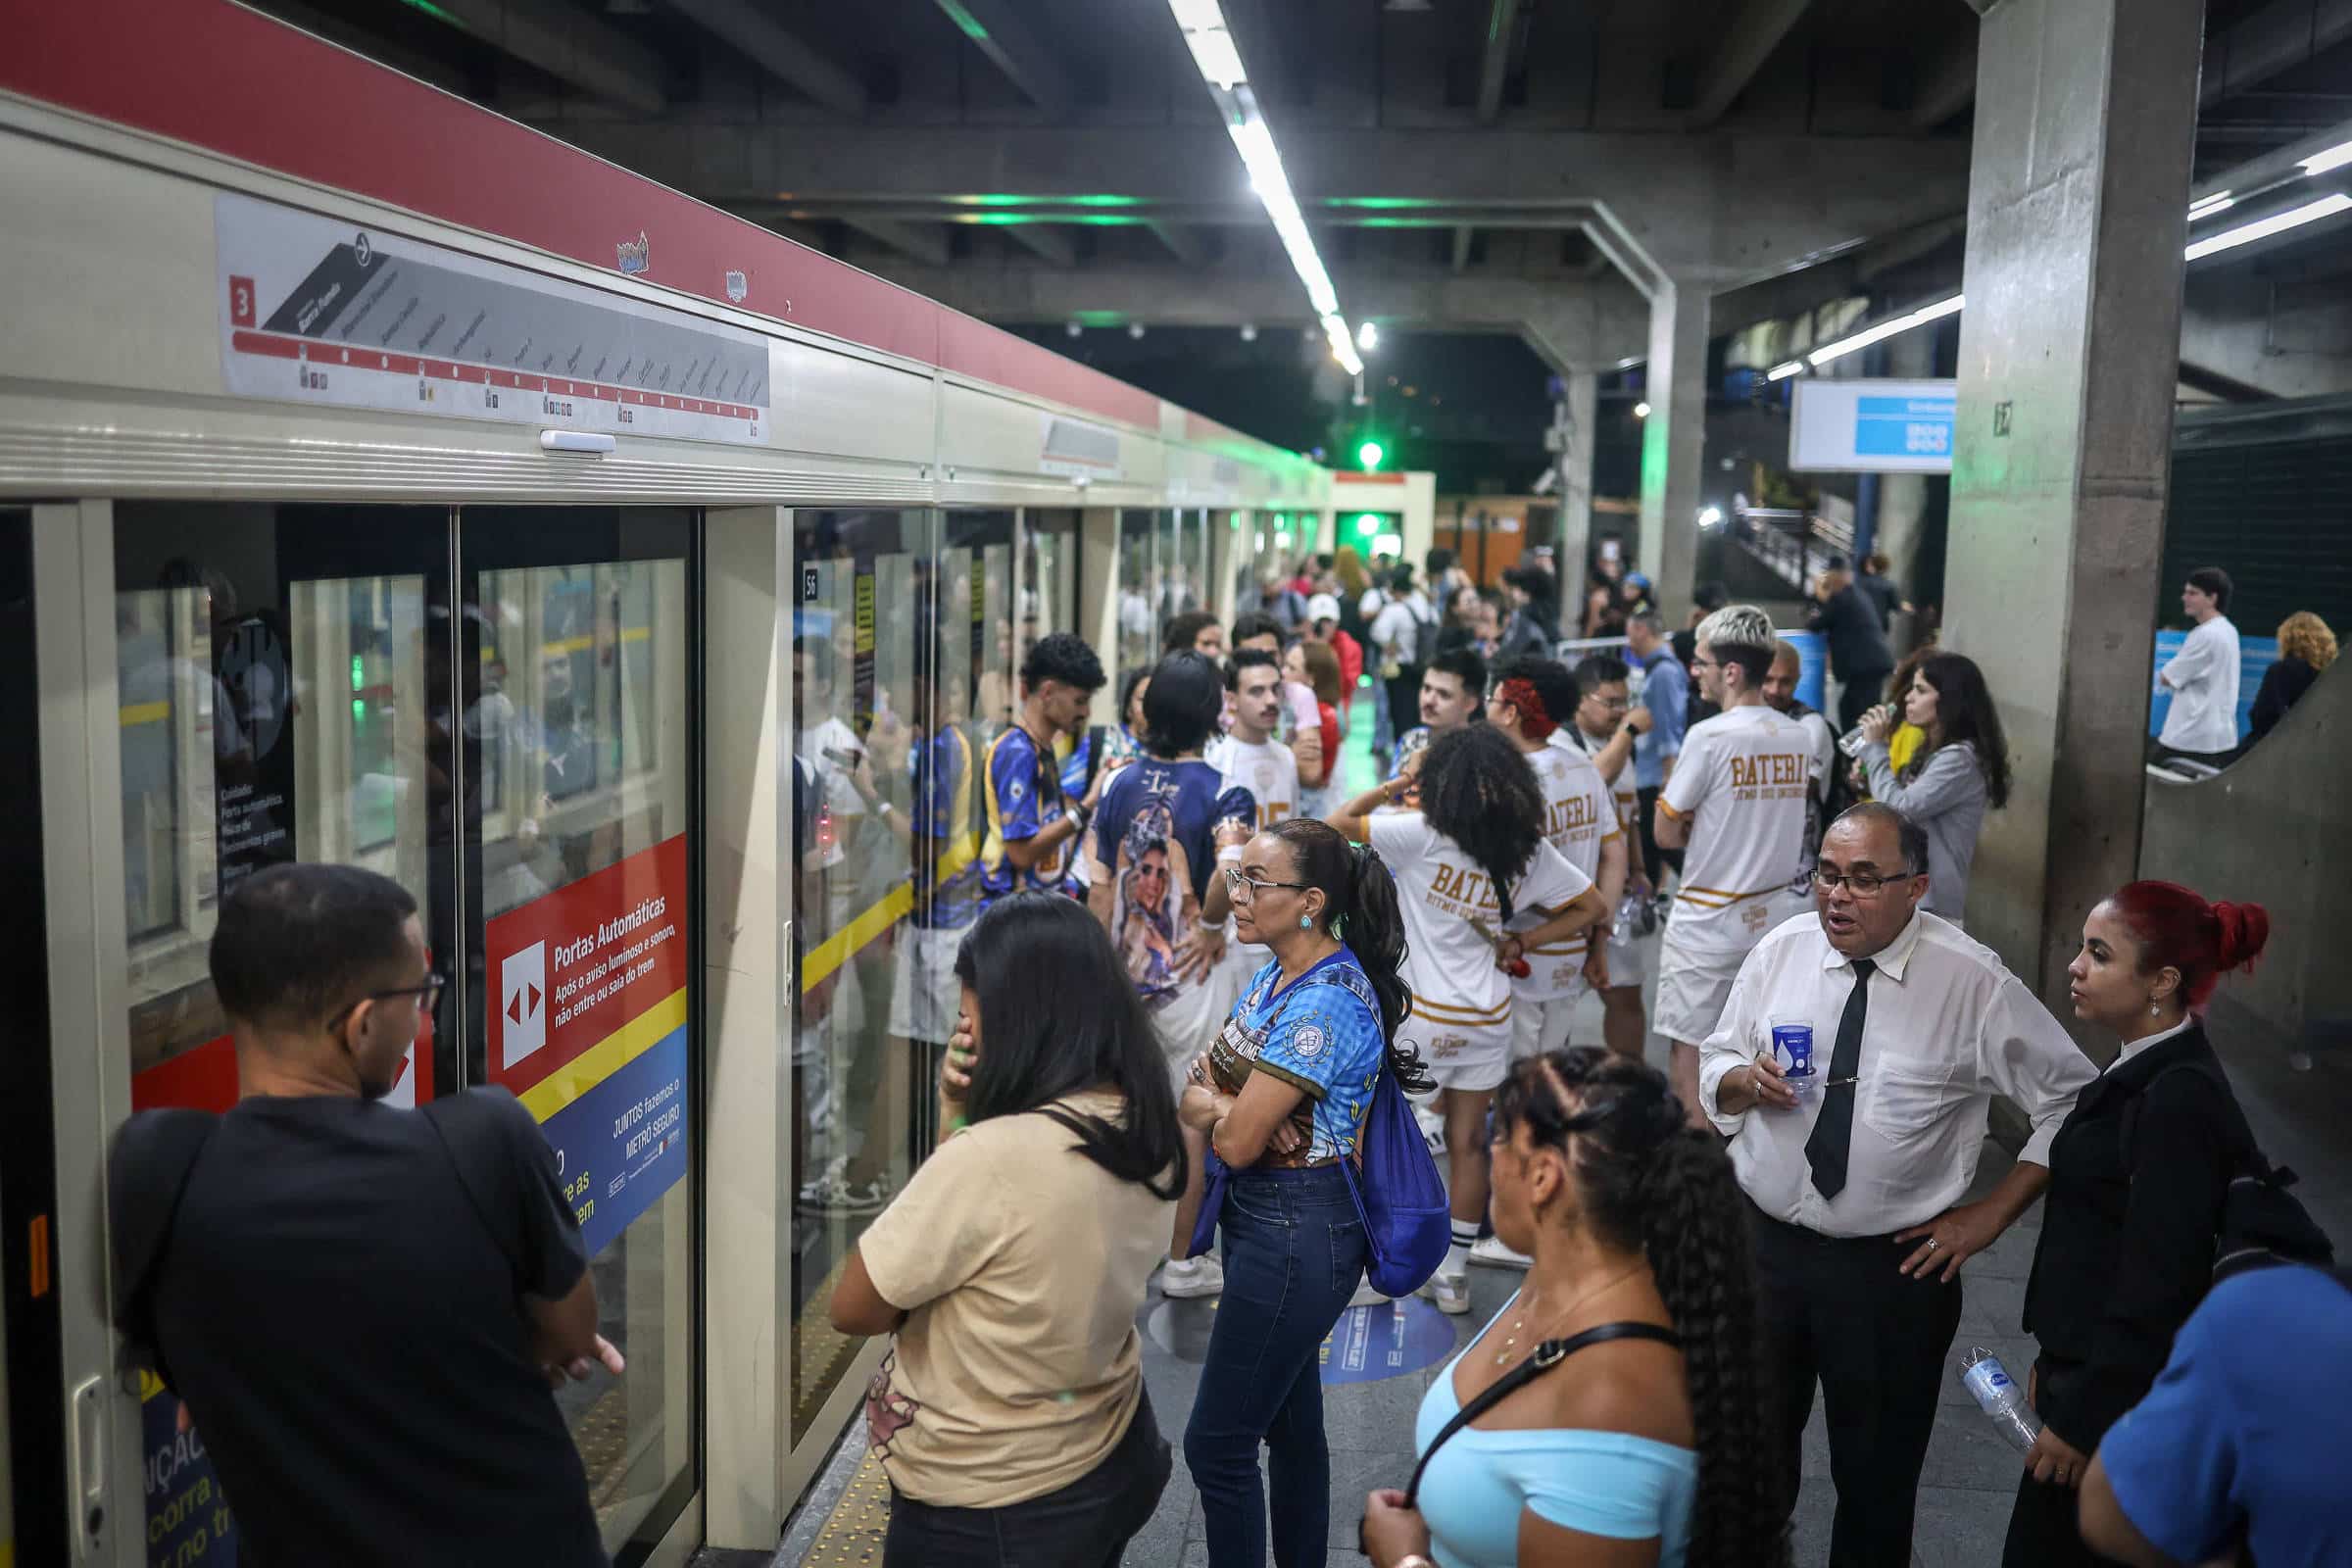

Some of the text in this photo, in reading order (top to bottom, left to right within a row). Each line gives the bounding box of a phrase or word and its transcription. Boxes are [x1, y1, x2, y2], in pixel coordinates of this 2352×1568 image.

[235, 287, 249, 316] 3
[1731, 754, 1809, 787] BATERI
[555, 896, 665, 972] Portas Automáticas
[555, 924, 676, 1004] Após o aviso luminoso e sonoro,
[555, 957, 655, 1029] não entre ou saia do trem
[612, 1077, 680, 1140] JUNTOS fazemos o
[626, 1121, 652, 1160] METRÔ
[653, 1103, 680, 1138] SEGURO
[576, 1170, 590, 1196] as
[148, 1476, 212, 1544] corra
